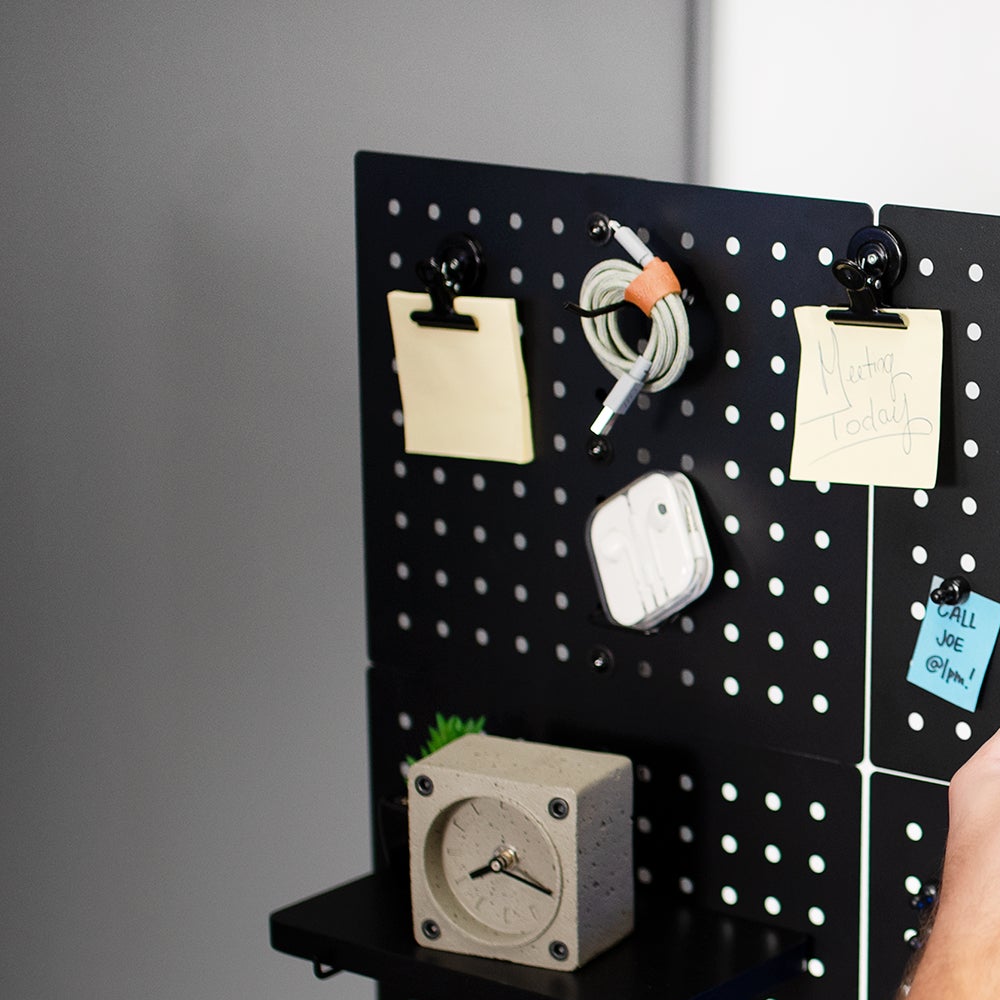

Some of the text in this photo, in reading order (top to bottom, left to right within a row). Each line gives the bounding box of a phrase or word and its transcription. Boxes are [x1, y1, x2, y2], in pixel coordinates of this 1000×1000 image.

[818, 327, 912, 407] Meeting
[800, 392, 933, 455] Today
[937, 603, 976, 629] CALL
[936, 629, 964, 652] JOE
